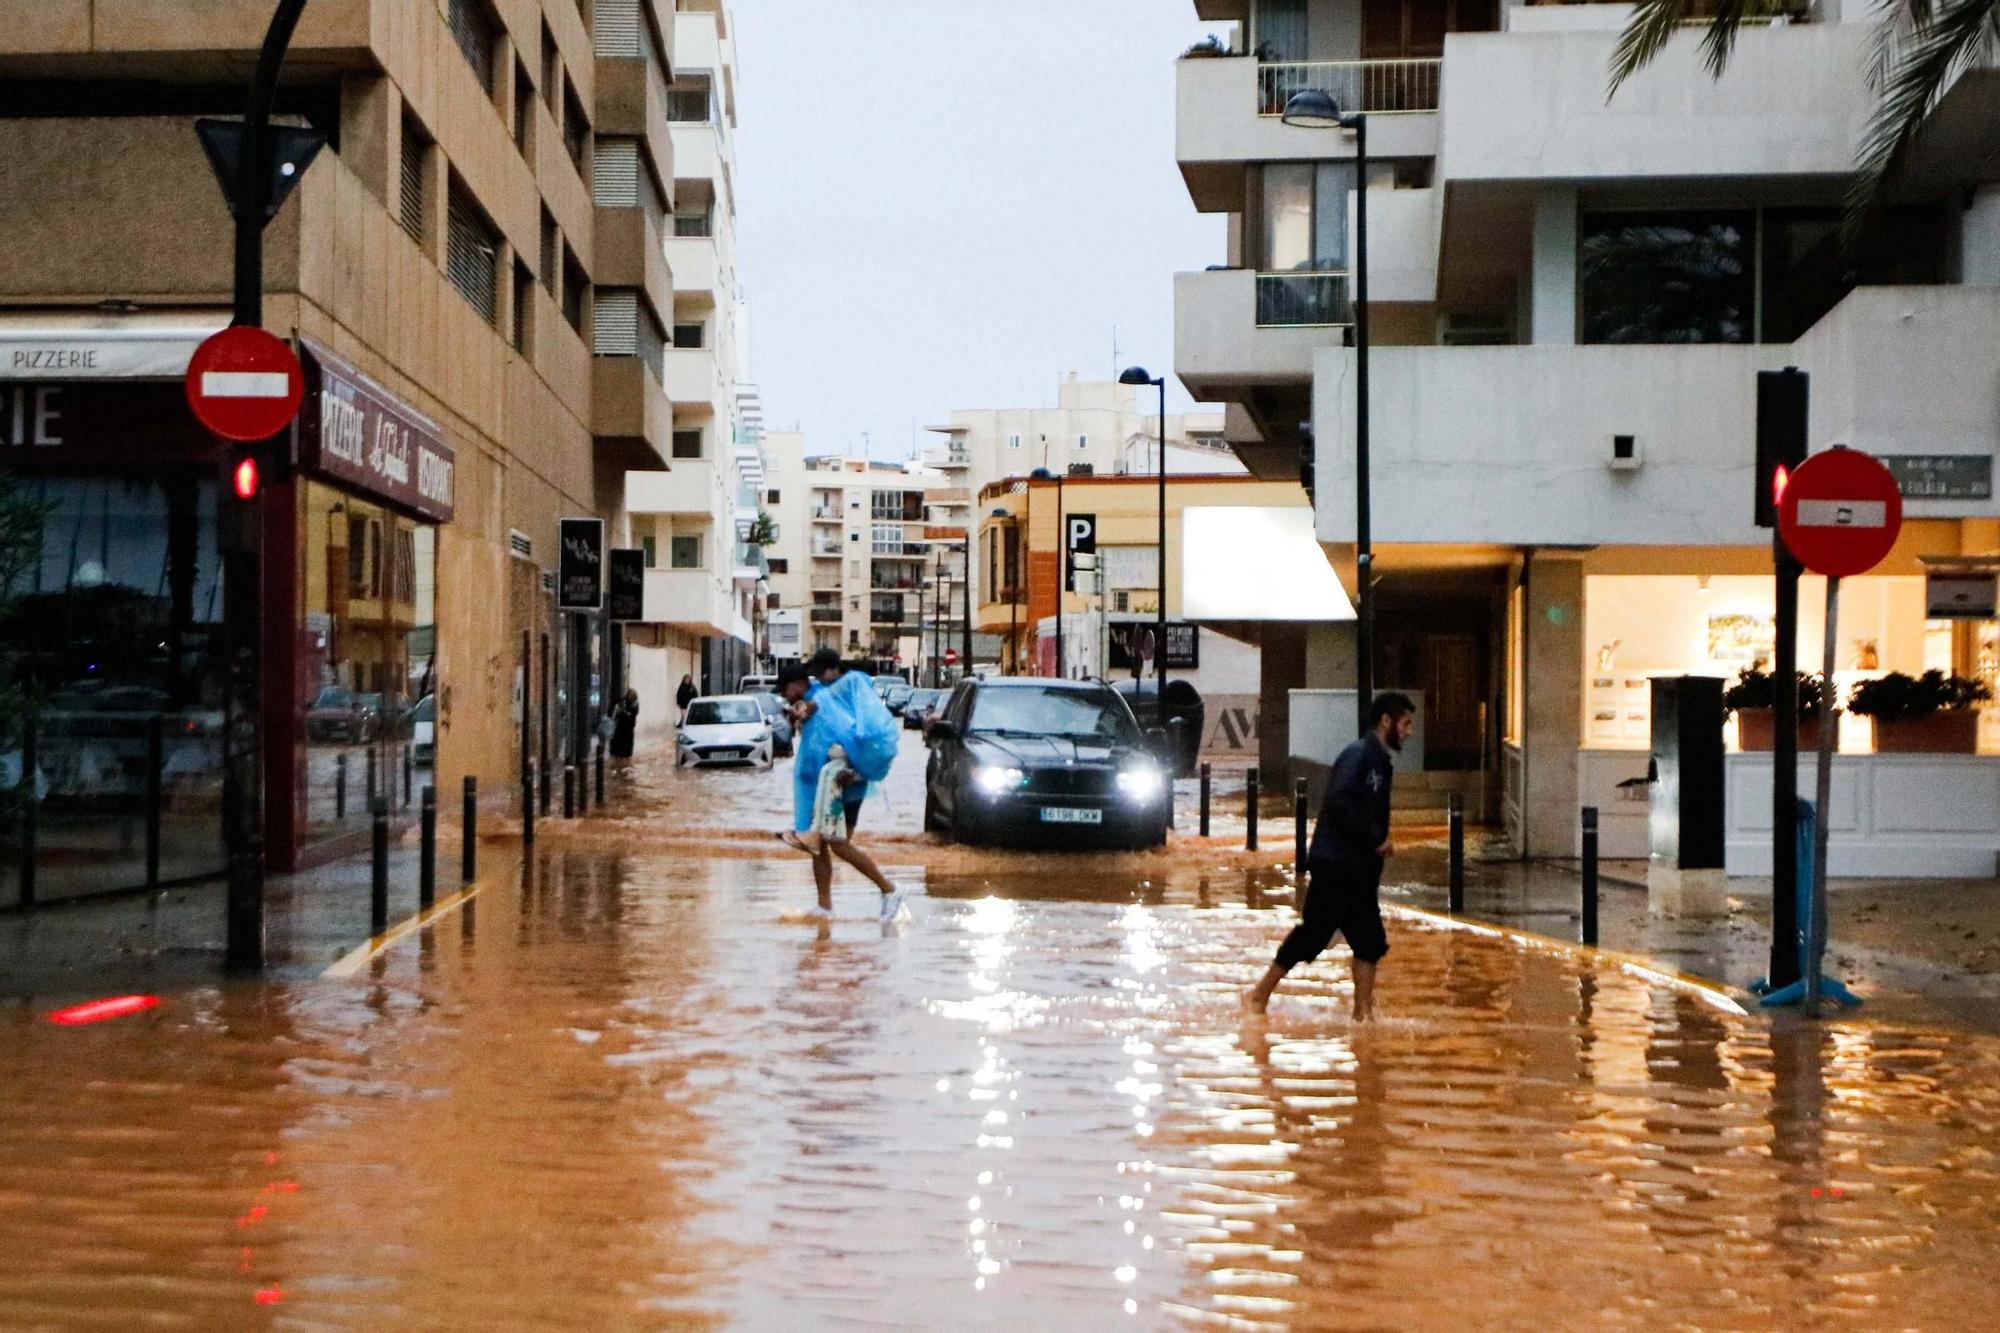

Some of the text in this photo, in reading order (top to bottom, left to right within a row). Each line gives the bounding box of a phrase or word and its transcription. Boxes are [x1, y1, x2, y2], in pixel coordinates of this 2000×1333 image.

[13, 350, 98, 368] PIZZERIE
[0, 386, 63, 446] IE
[1070, 519, 1092, 549] P
